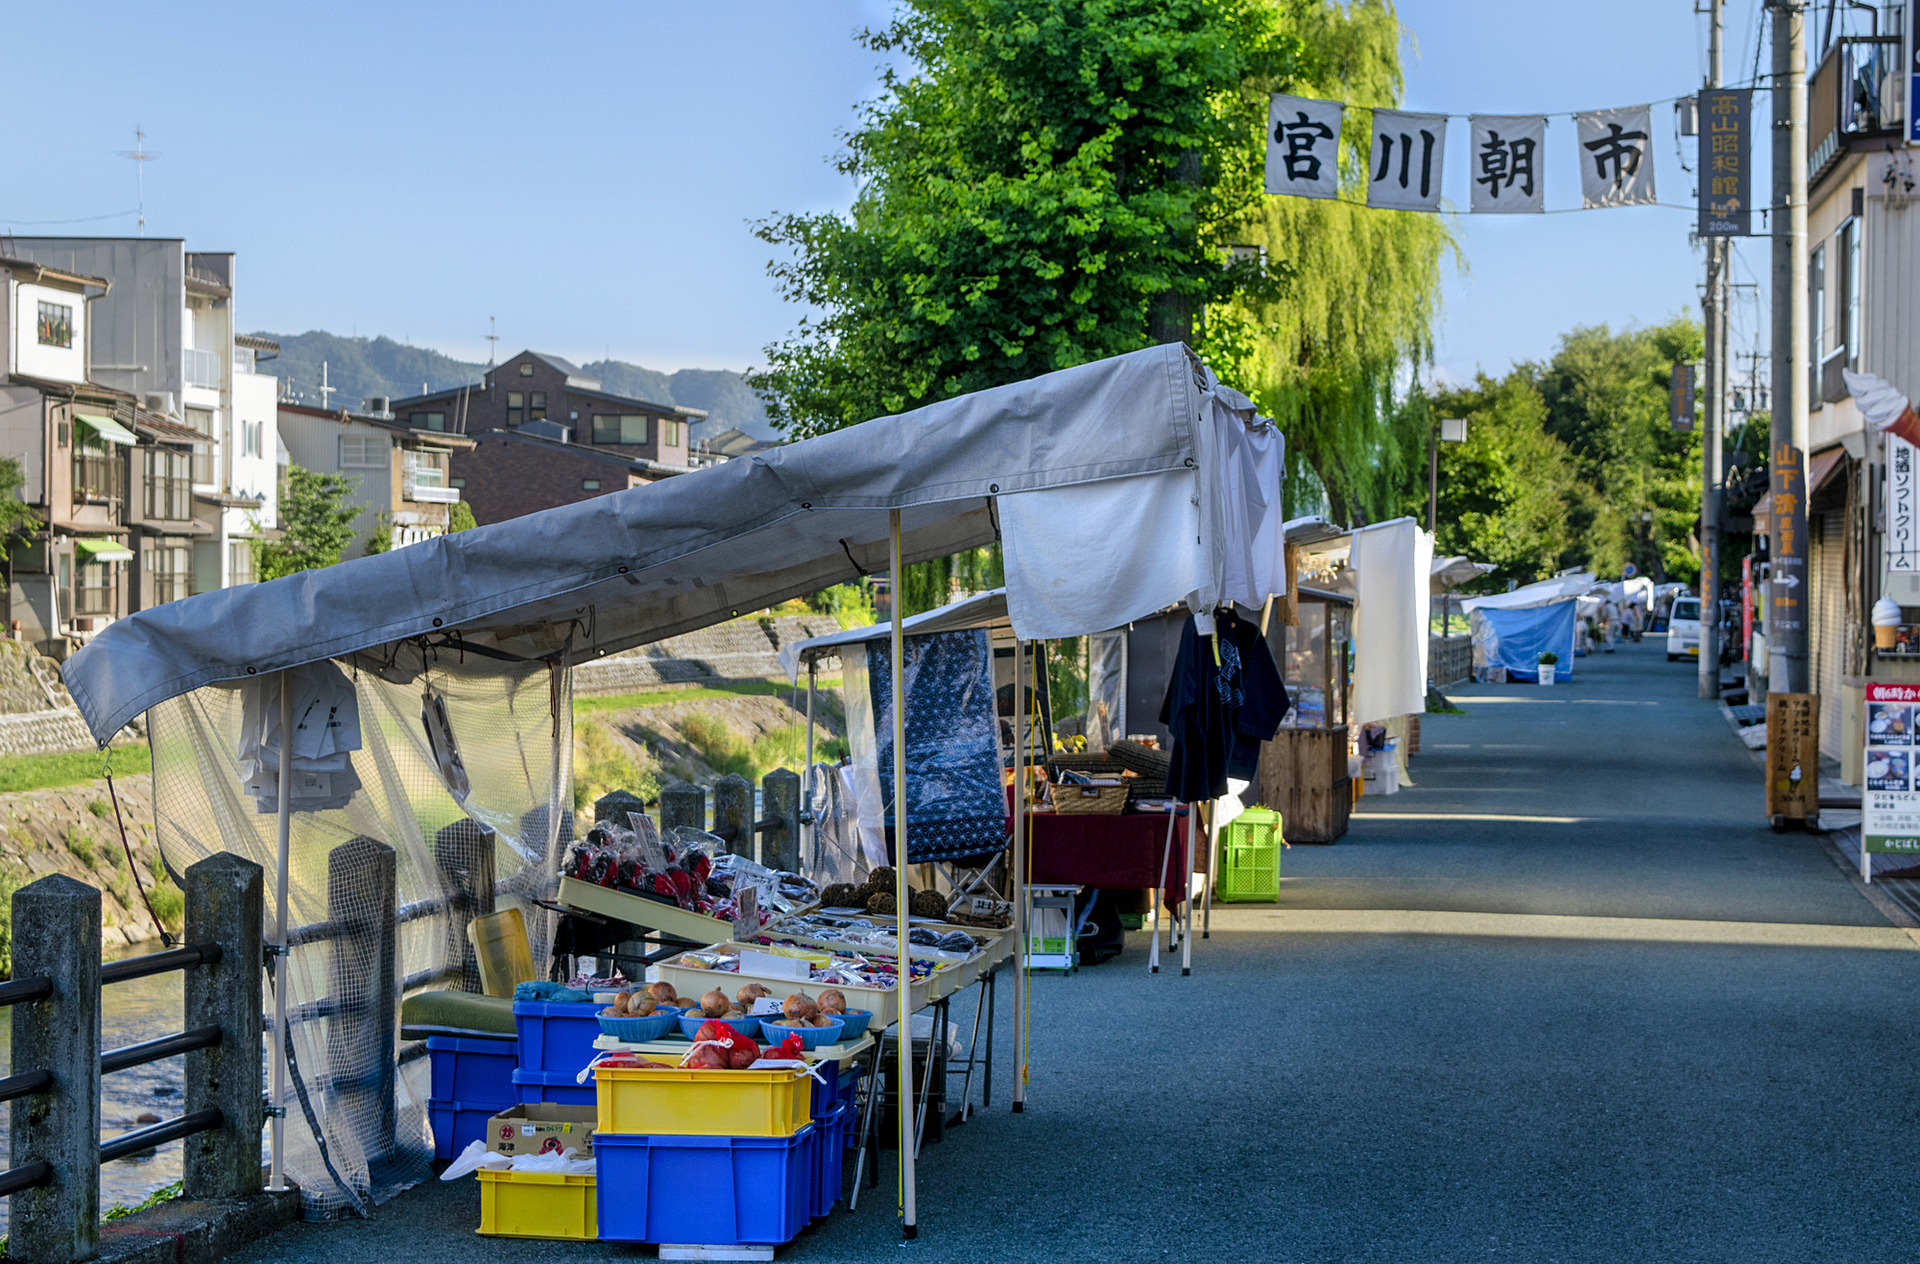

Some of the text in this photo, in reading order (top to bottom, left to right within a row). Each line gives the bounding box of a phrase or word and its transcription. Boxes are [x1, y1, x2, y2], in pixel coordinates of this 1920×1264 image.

[1274, 112, 1648, 198] 宮川朝市
[1711, 95, 1739, 195] 高山昭和館
[1708, 221, 1739, 232] 200m
[1895, 446, 1910, 569] 地酒ソフトクリーム
[498, 1142, 516, 1152] 海津
[501, 1127, 514, 1139] か
